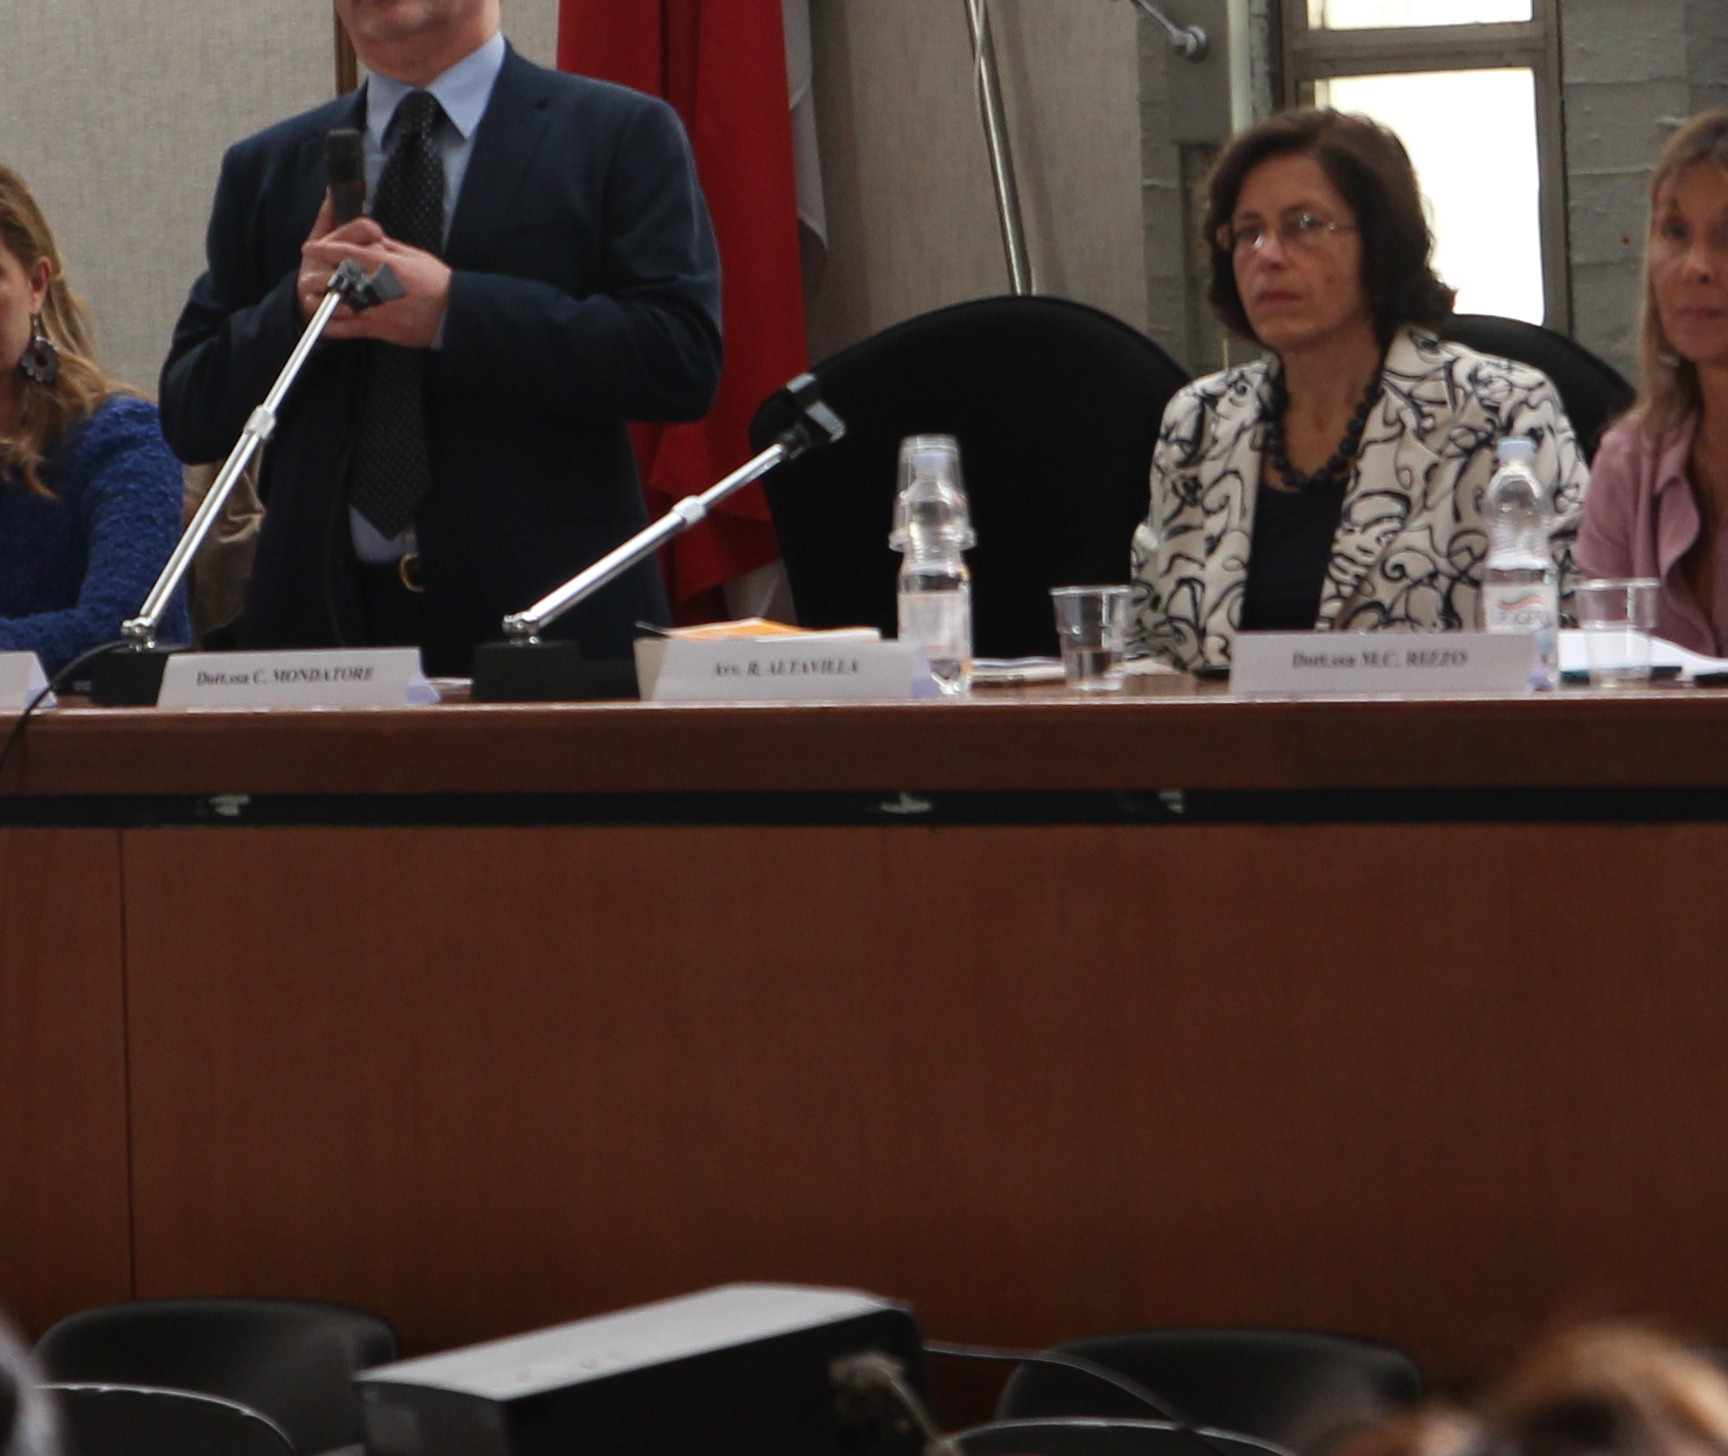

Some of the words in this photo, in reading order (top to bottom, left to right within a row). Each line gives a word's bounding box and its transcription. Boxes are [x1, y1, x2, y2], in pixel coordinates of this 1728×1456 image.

[1405, 650, 1468, 667] RIZZO
[273, 666, 375, 684] MONDATORE
[766, 659, 859, 676] ALTAVILLA
